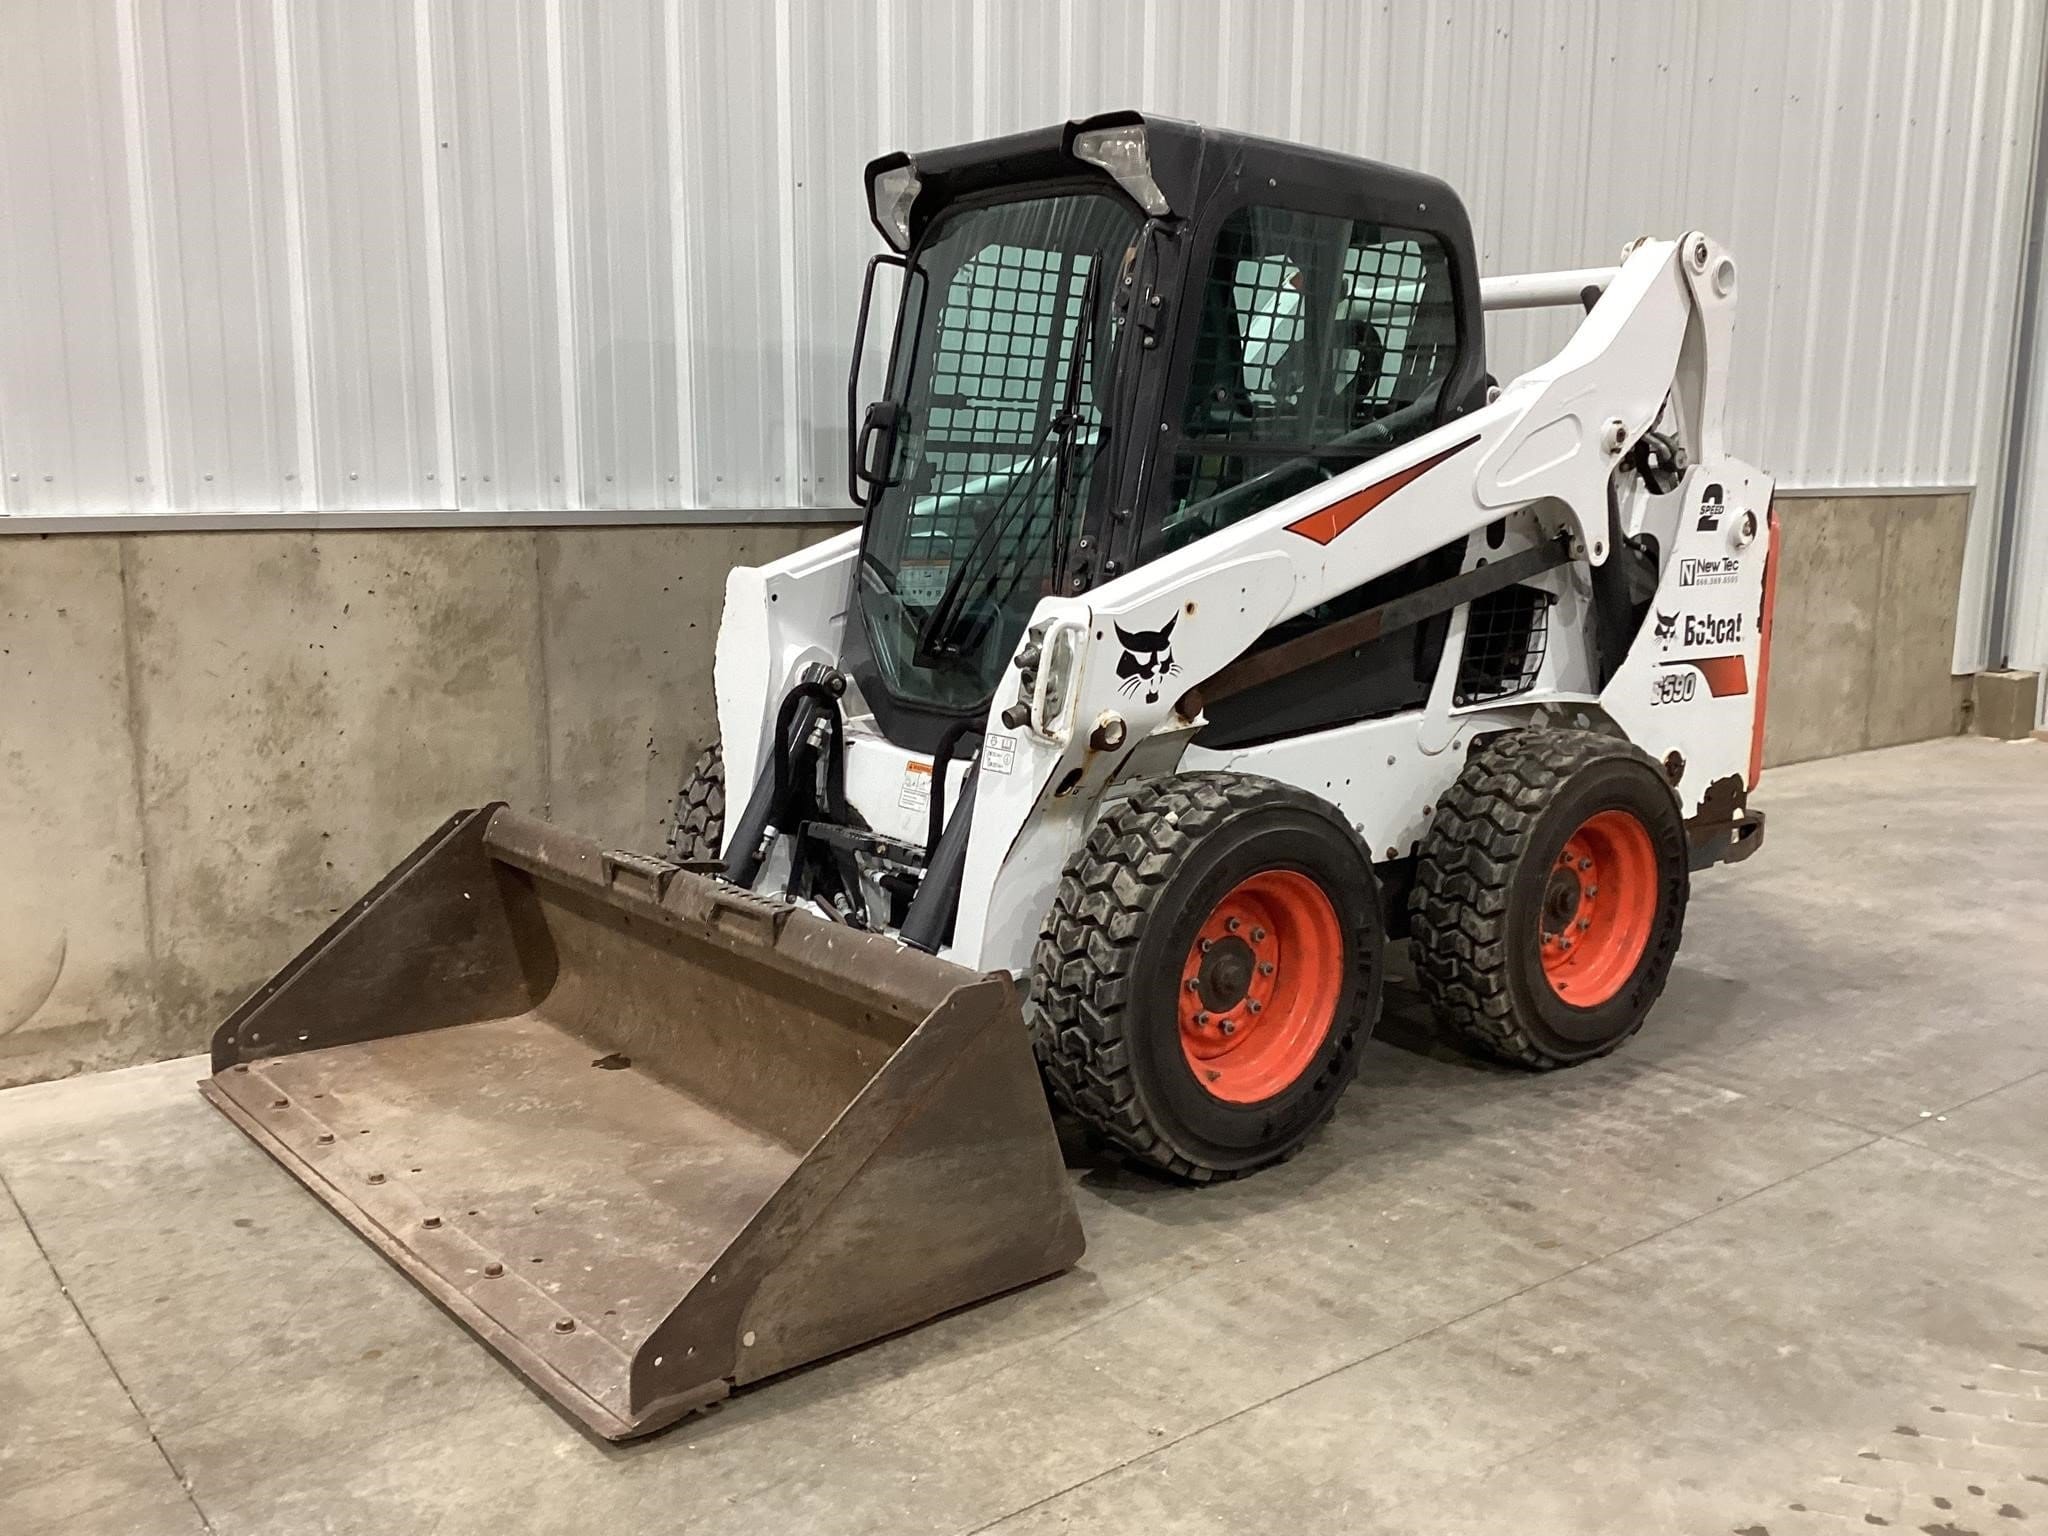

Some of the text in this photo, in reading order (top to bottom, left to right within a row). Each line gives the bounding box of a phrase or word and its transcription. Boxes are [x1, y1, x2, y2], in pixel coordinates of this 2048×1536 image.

[1697, 483, 1723, 531] 2
[1700, 505, 1724, 515] SPEED
[1697, 559, 1720, 573] New
[1722, 557, 1739, 571] Tec
[1684, 613, 1742, 646] Bobcat
